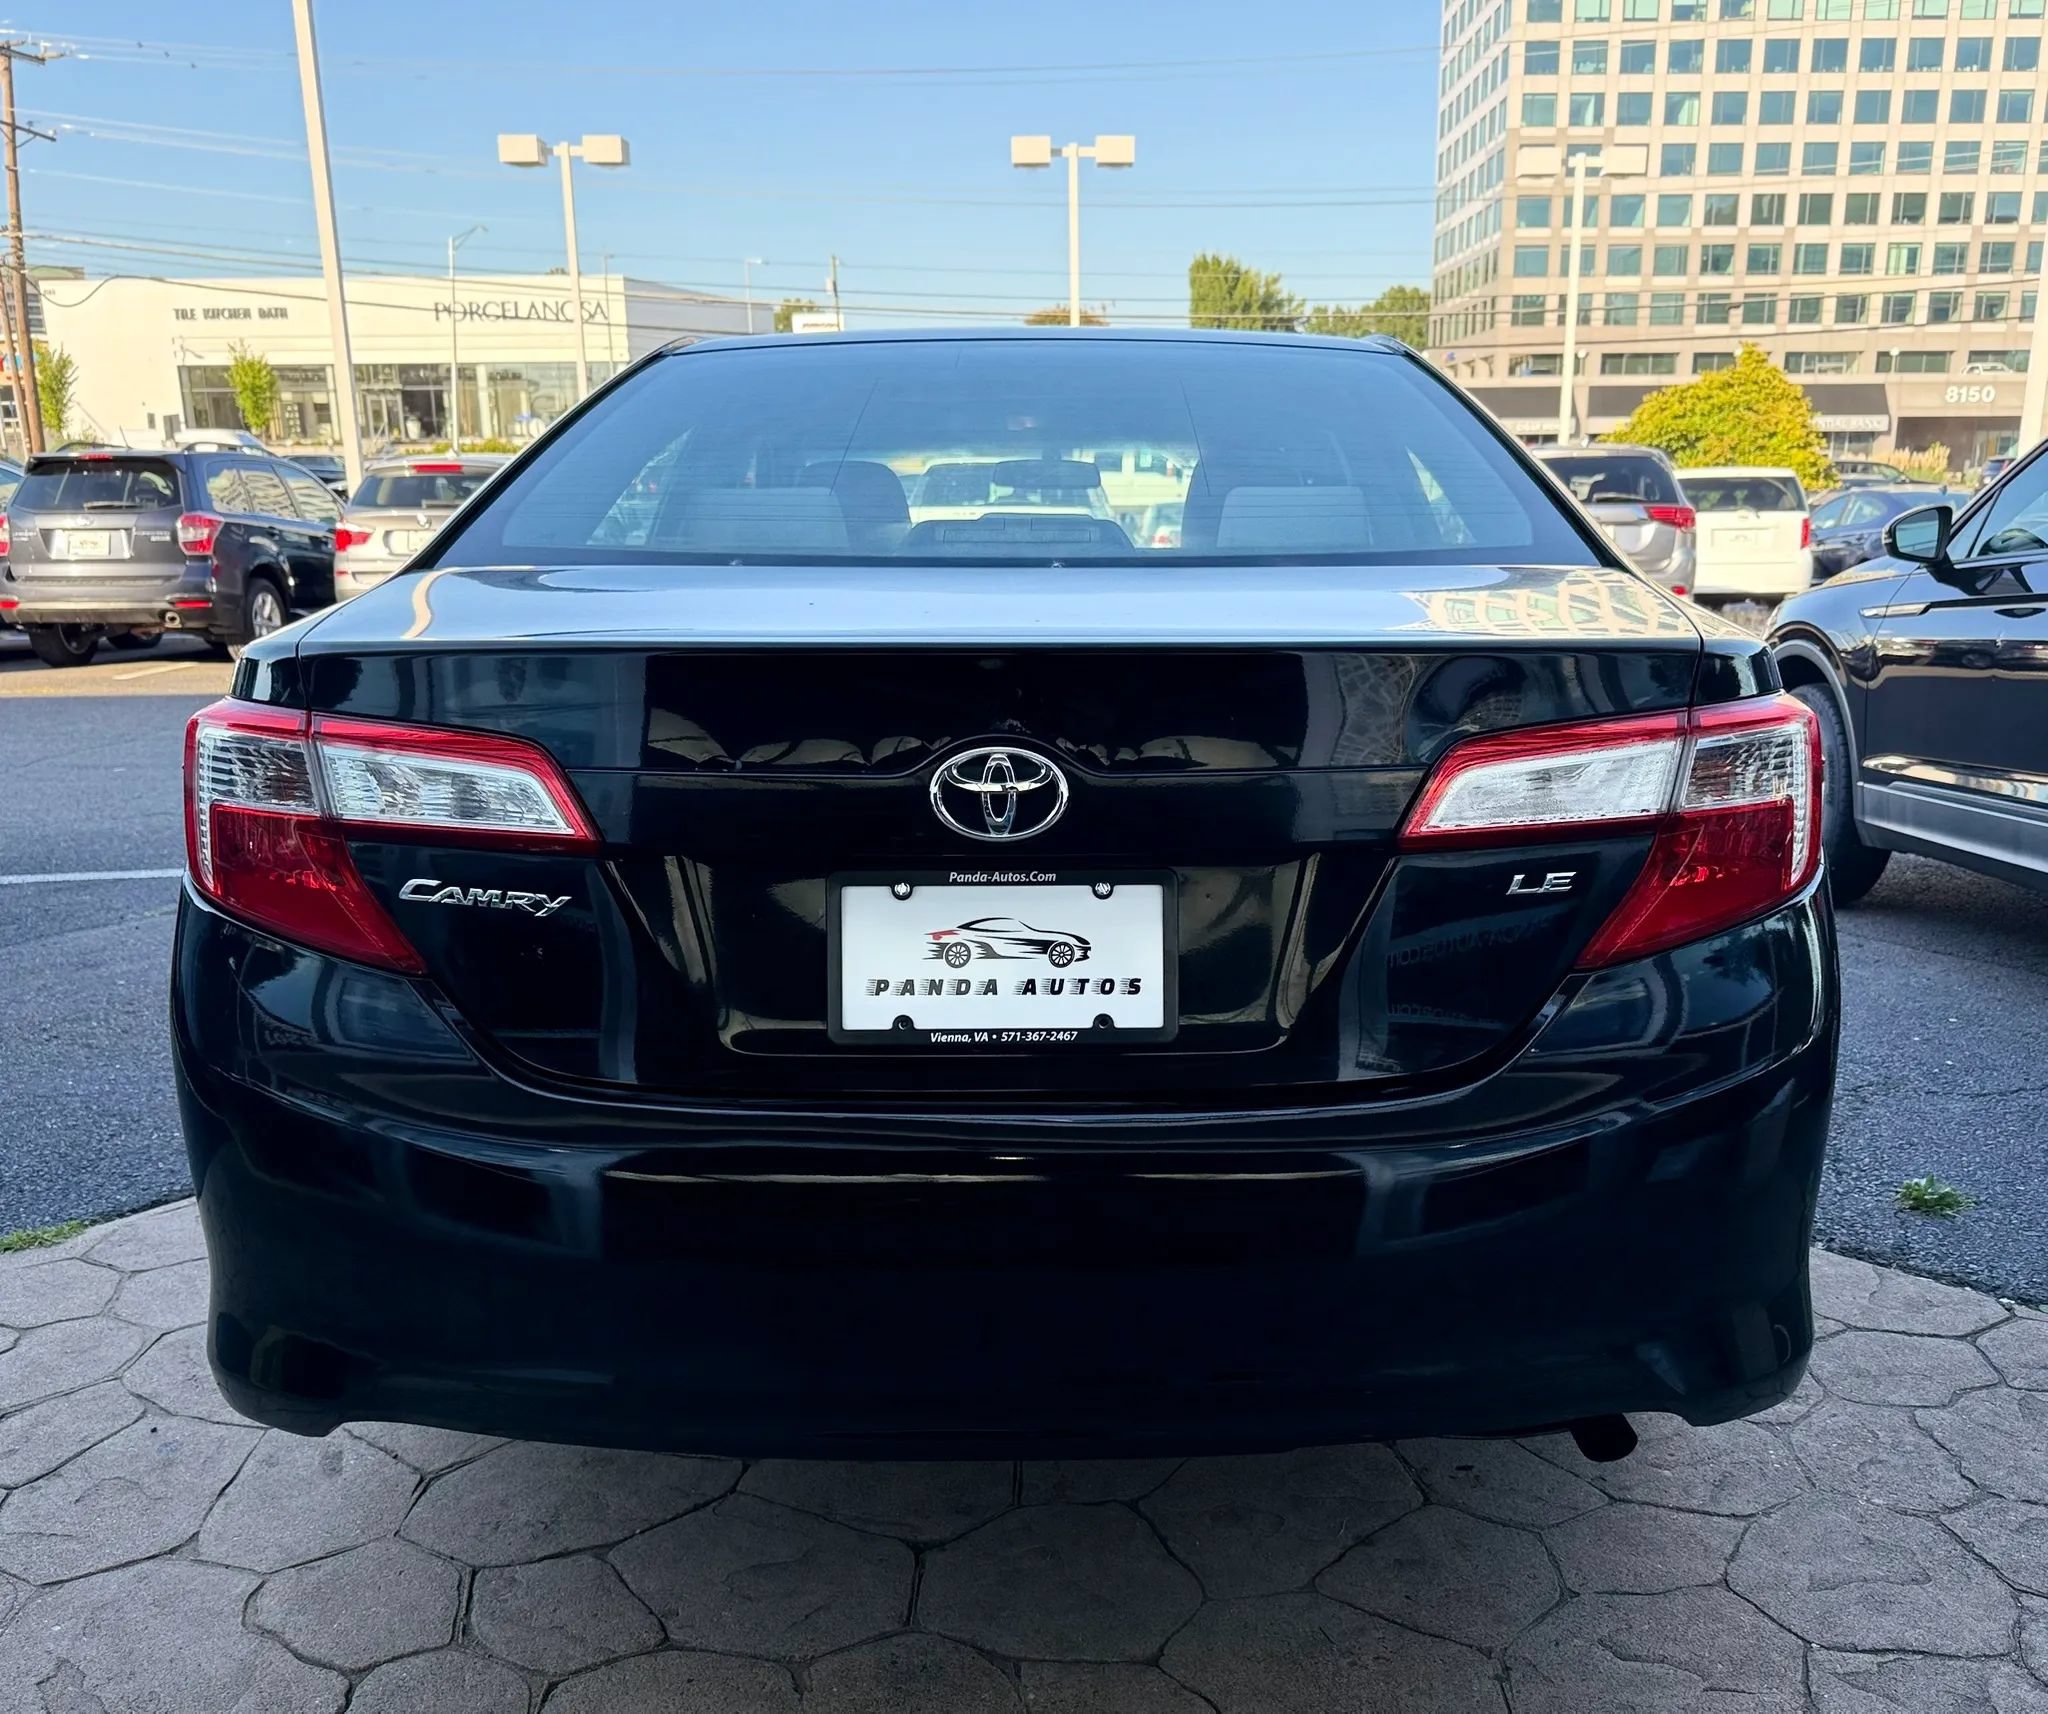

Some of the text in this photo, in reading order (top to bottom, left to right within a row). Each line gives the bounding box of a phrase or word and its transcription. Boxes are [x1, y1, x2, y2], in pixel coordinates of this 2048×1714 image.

[434, 300, 608, 322] PORCELANOSA
[1945, 385, 1997, 403] 8150
[949, 871, 1058, 884] Panda-Autos.Com
[1505, 870, 1577, 896] LE
[398, 877, 573, 917] CAMRY
[865, 977, 1142, 997] PANDA AUTOS
[930, 1031, 1078, 1044] Vienna, VA 571-367-2467
